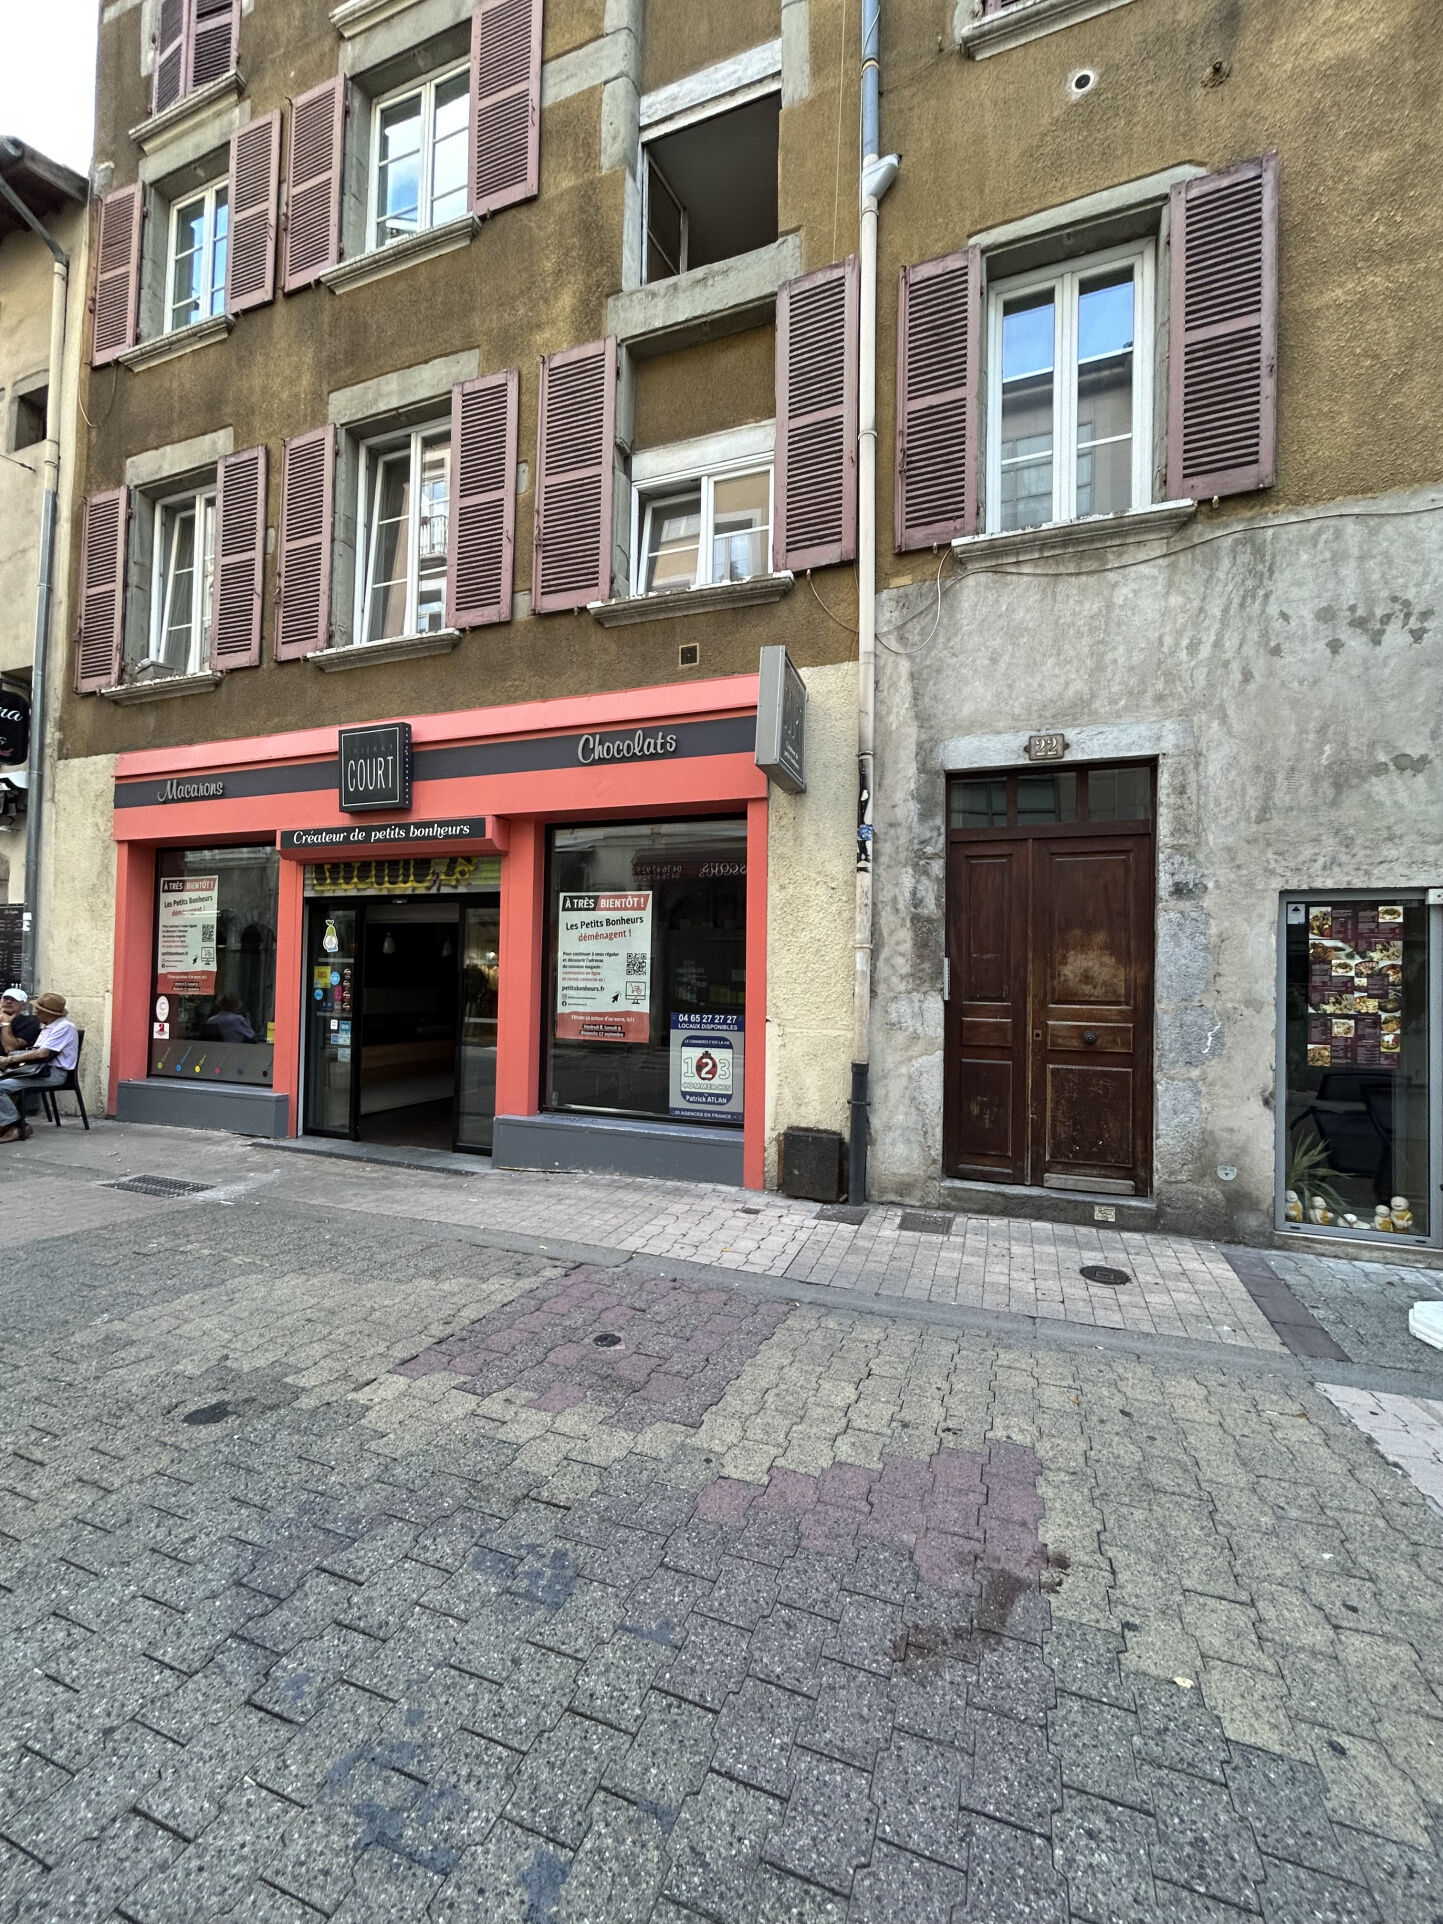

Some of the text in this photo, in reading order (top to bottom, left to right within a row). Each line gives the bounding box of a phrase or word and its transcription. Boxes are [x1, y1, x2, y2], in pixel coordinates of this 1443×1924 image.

[578, 730, 677, 763] Chocolats
[1035, 737, 1057, 756] 22
[347, 755, 394, 792] COURT
[157, 779, 223, 801] Macarons
[293, 823, 470, 845] Créateur de petits bonheurs
[164, 881, 169, 890] À
[169, 881, 183, 890] TRÈS
[173, 898, 188, 907] Petits
[189, 895, 213, 904] Bonheurs
[565, 896, 644, 909] À TRÈS BIENTÔT !
[565, 916, 644, 931] Les Petits Bonheurs
[578, 928, 632, 942] déménagent !
[678, 1014, 737, 1024] 04 65 27 27 27
[682, 1081, 731, 1092] COMMERCES
[685, 1094, 727, 1104] Patrick ATLAN
